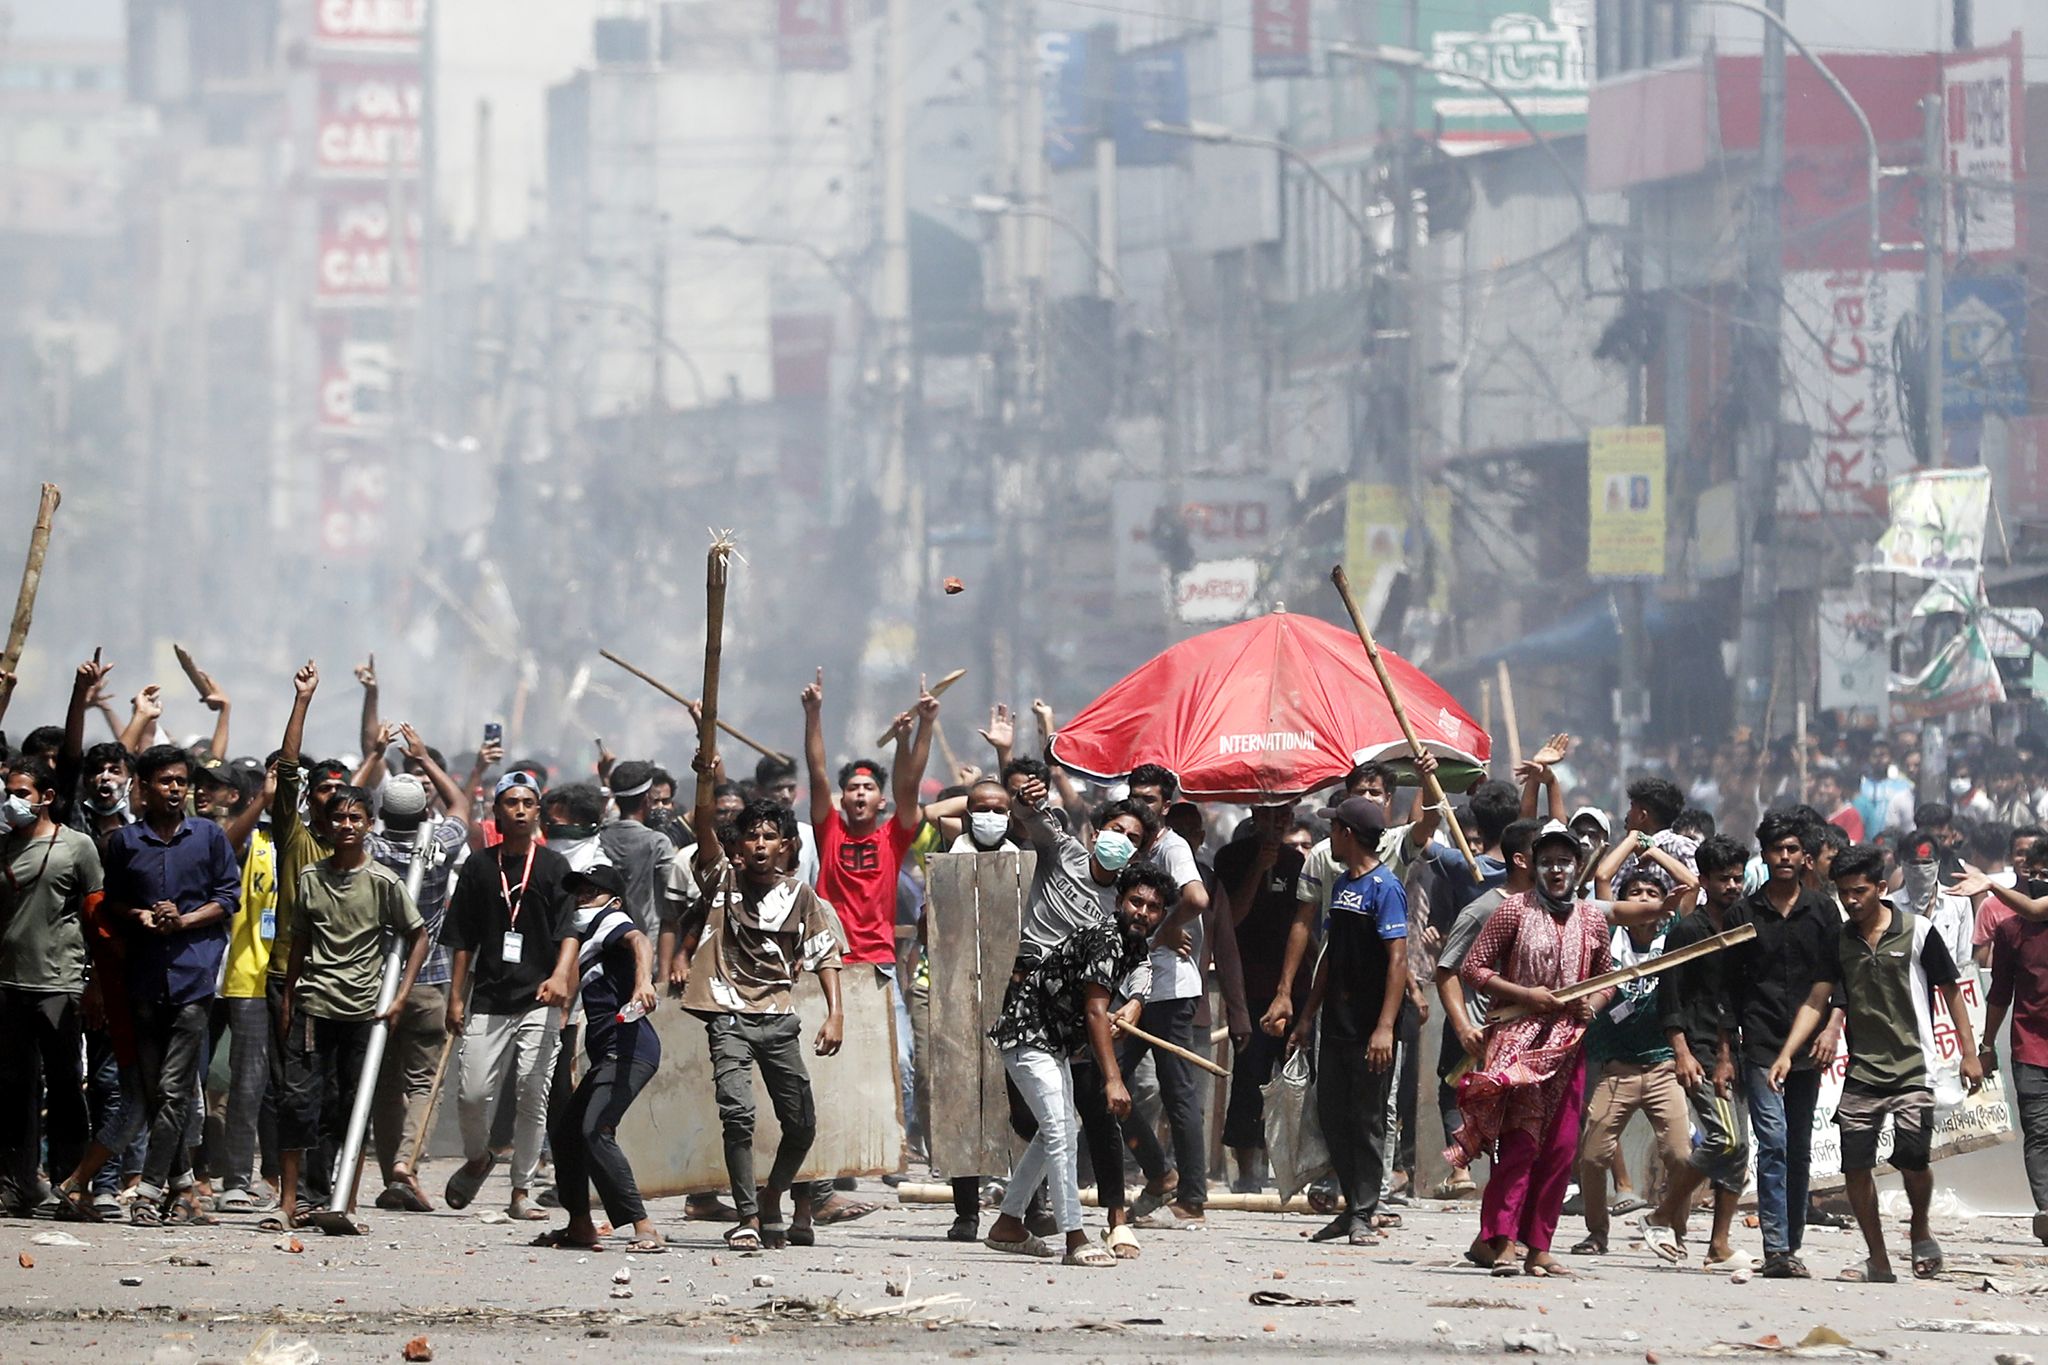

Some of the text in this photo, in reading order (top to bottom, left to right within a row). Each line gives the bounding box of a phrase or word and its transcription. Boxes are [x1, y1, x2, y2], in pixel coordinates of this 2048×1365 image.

[1218, 731, 1318, 754] INTERNATIONAL
[1056, 878, 1107, 923] The kin
[803, 928, 831, 959] NIKE
